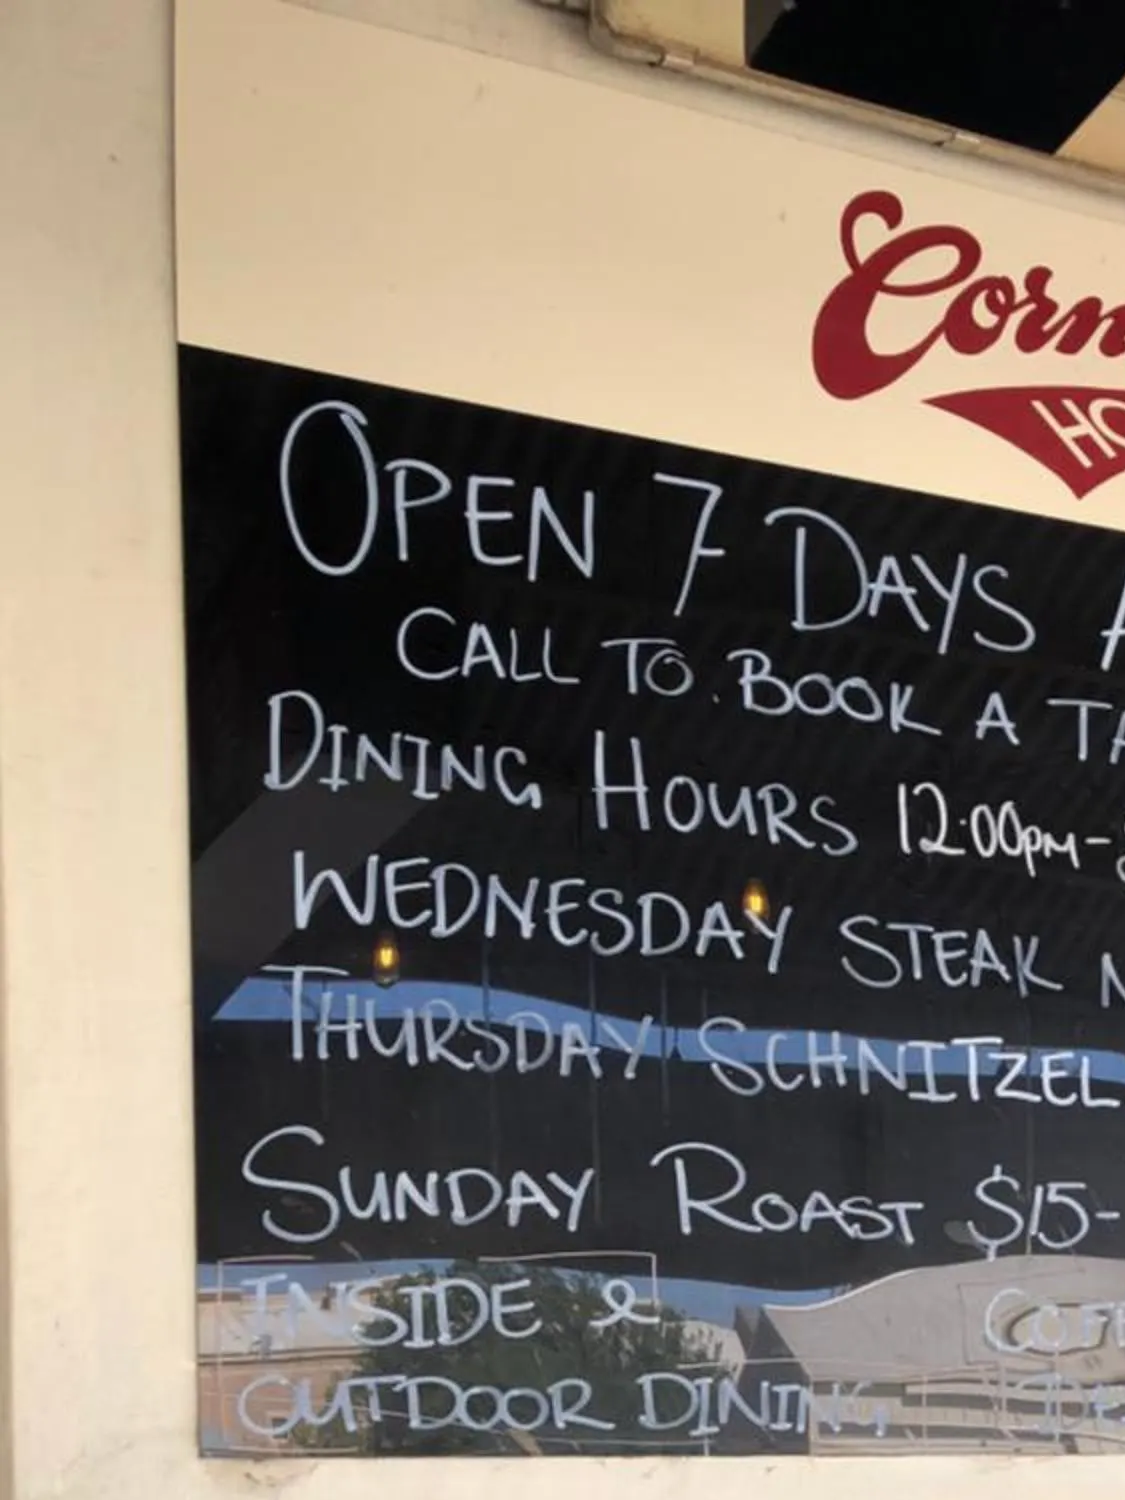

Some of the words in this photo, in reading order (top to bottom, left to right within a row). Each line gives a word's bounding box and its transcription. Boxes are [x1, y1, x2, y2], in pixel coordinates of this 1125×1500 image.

[280, 401, 594, 582] OPEN
[654, 472, 725, 618] 7
[765, 506, 1036, 656] DAYS
[398, 606, 582, 684] CALL
[599, 637, 694, 697] TO
[725, 649, 942, 735] BOOK
[975, 691, 1020, 746] A
[262, 689, 544, 811] DINING
[591, 729, 859, 857] HOURS
[292, 849, 792, 975] WEDNESDAY
[840, 914, 1064, 999] STEAK
[261, 963, 654, 1081] THURSDAY
[699, 1015, 1121, 1108] SCHNITZEL
[241, 1124, 595, 1244] SUNDAY
[649, 1141, 924, 1245] ROAST
[240, 1272, 543, 1349] INSIDE
[236, 1372, 616, 1437] OUTDOOR
